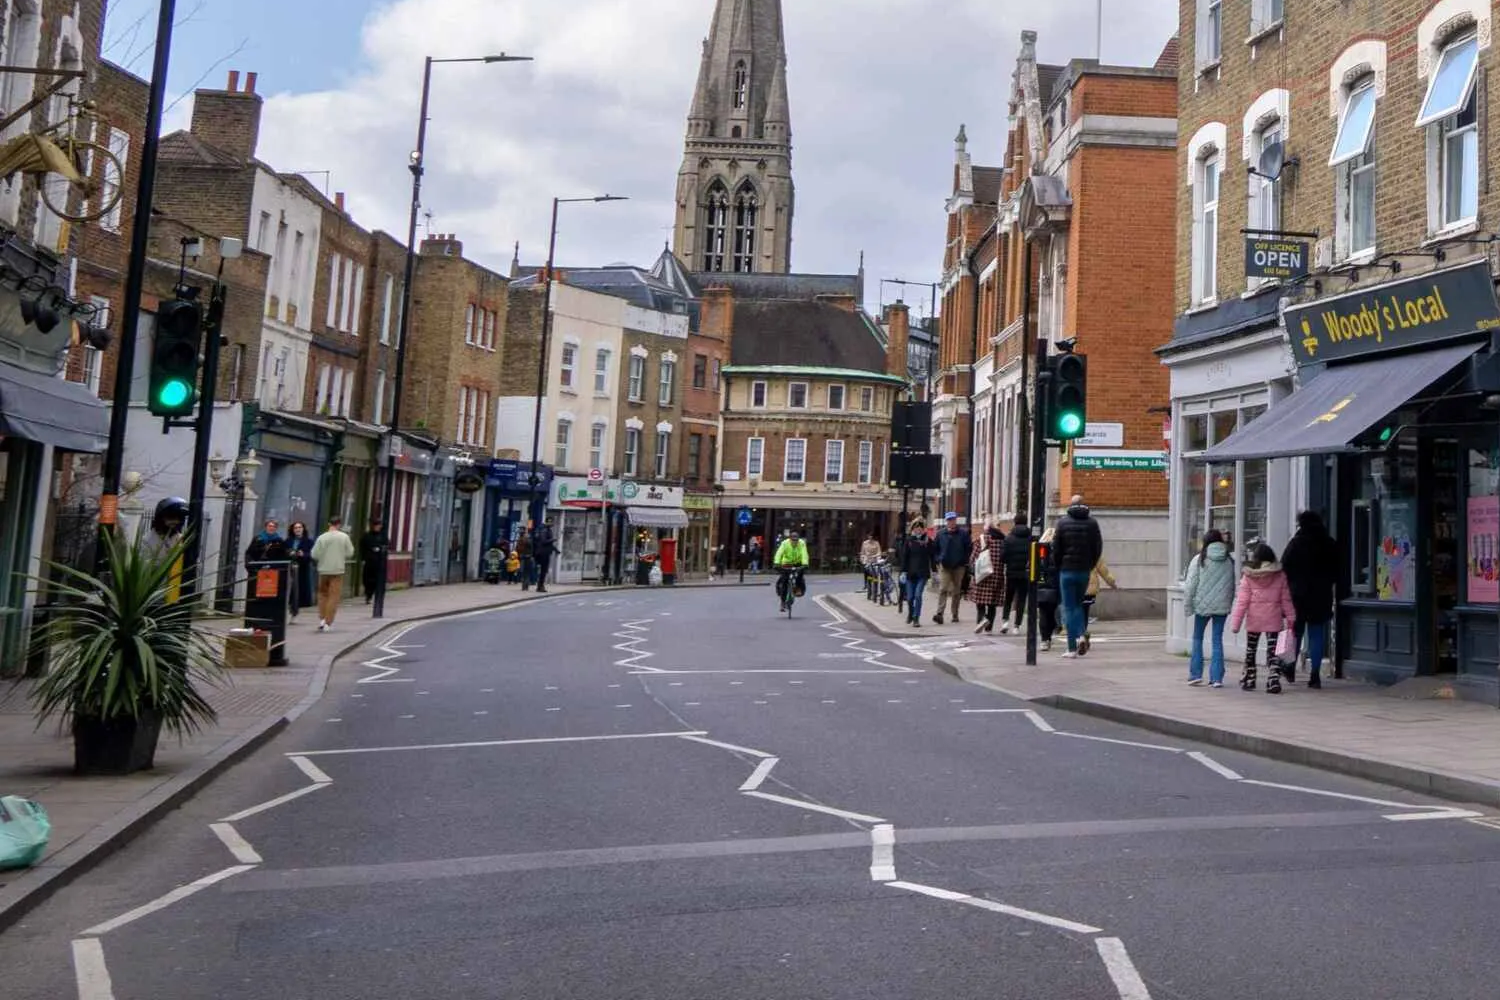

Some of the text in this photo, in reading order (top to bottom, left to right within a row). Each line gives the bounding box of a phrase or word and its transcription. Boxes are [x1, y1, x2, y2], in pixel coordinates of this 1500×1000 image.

[1254, 242, 1300, 252] OFF LICENCE
[1253, 250, 1301, 268] OPEN
[1321, 284, 1449, 343] Woody's Local
